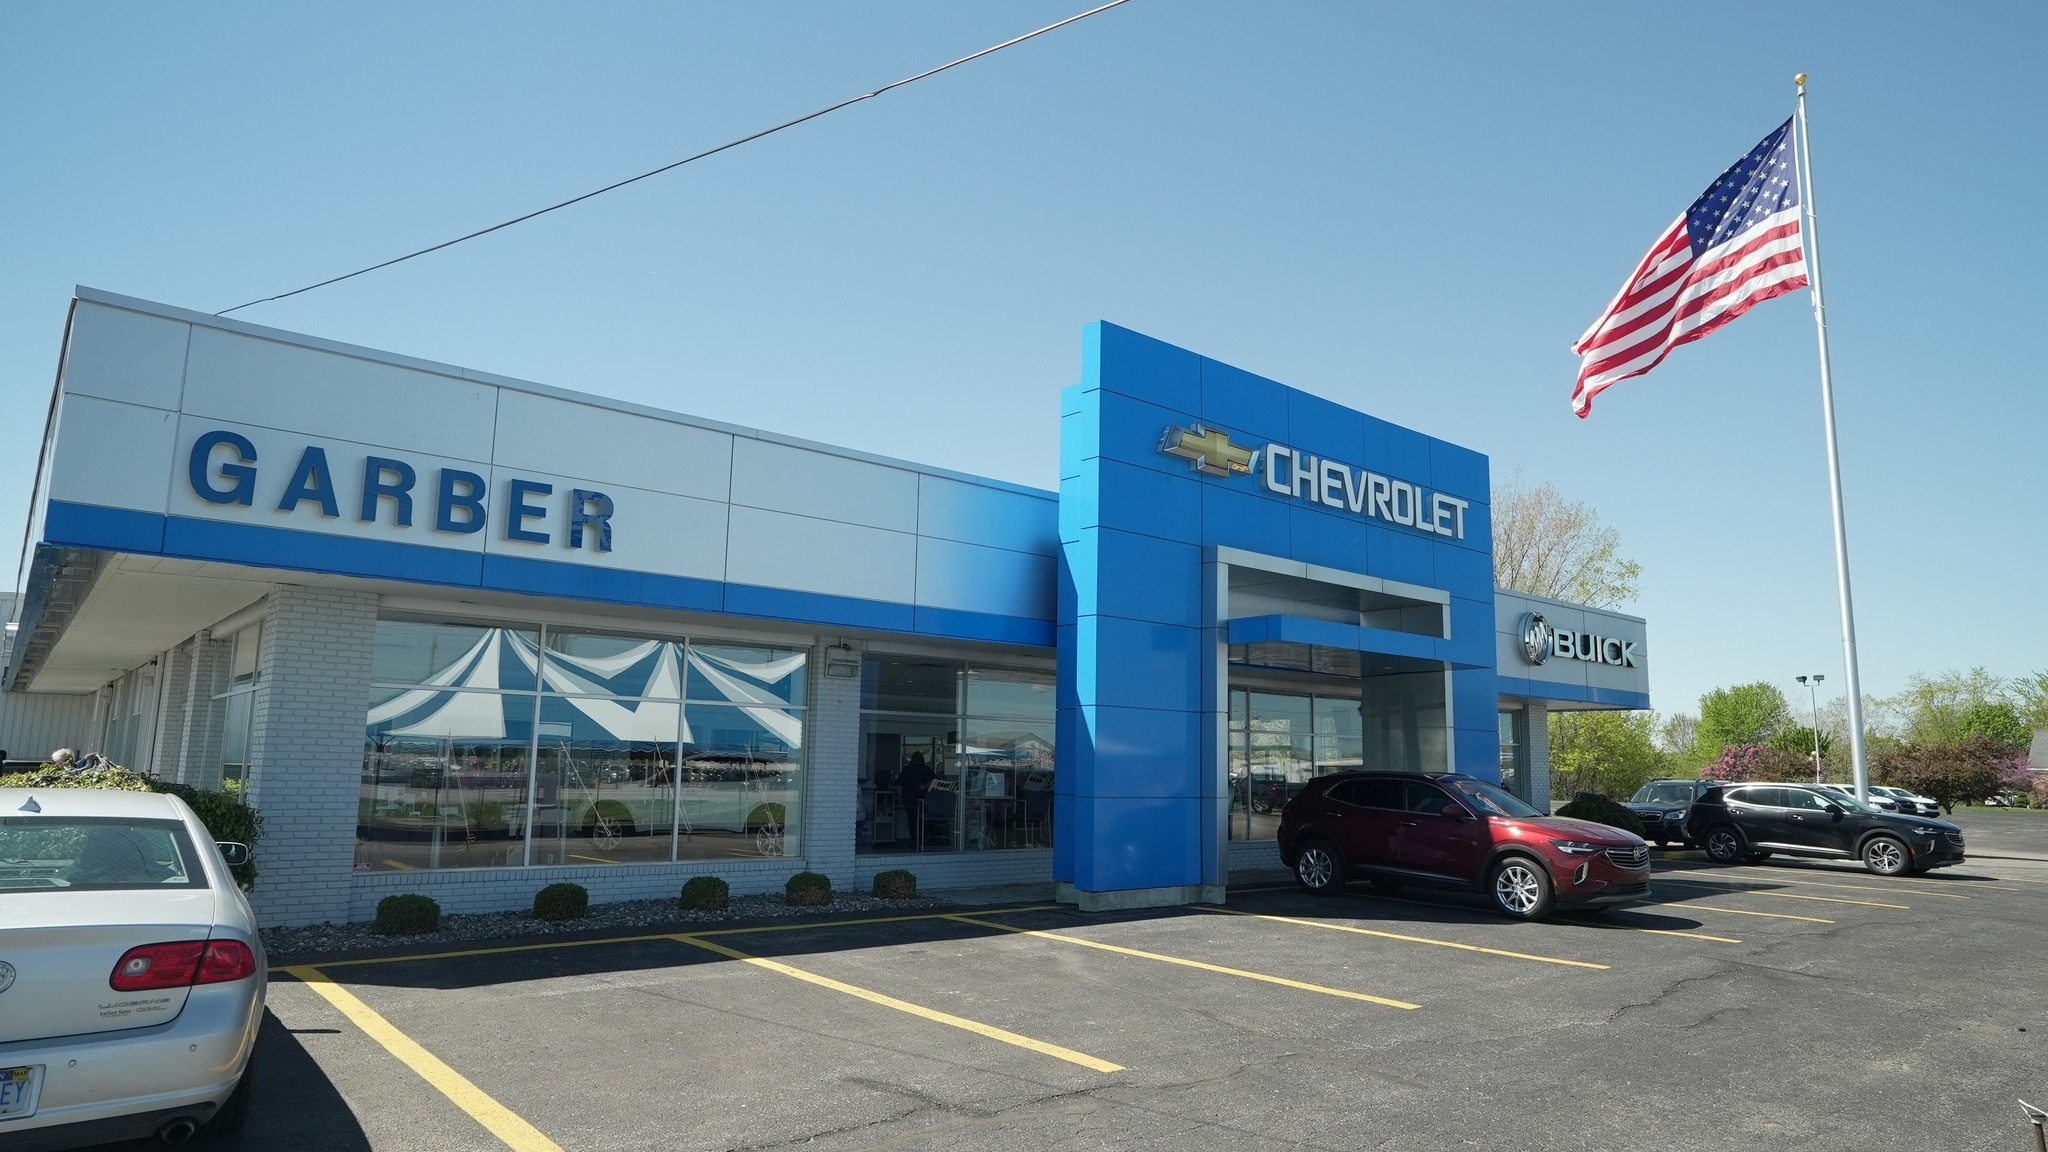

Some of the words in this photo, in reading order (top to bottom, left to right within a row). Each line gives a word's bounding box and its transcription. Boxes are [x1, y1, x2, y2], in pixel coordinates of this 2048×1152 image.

[188, 430, 615, 553] GARBER
[1261, 443, 1469, 540] CHEVROLET
[1551, 627, 1641, 668] BUICK
[98, 997, 170, 1010] LUCERNE
